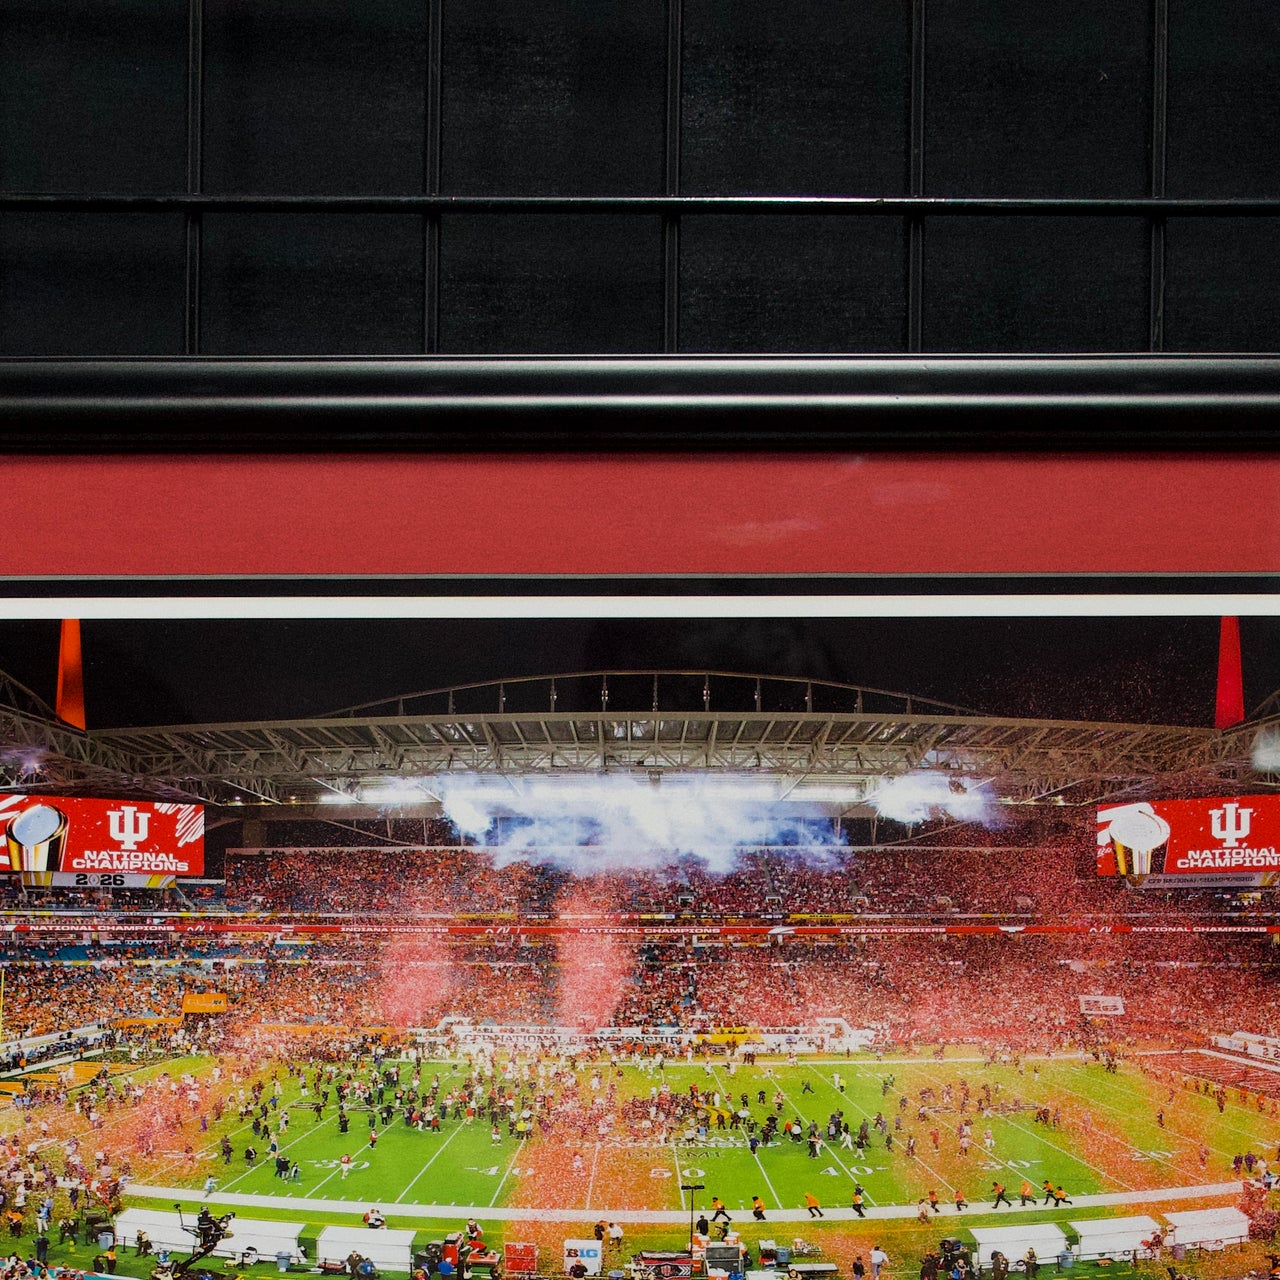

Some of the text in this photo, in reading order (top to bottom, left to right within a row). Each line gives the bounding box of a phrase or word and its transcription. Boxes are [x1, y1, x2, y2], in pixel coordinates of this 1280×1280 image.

[84, 850, 178, 863] NATIONAL
[1187, 847, 1280, 860] NATIONAL
[72, 859, 189, 872] CHAMPIONS
[493, 1034, 563, 1044] NATIONAL
[648, 1167, 706, 1178] 50
